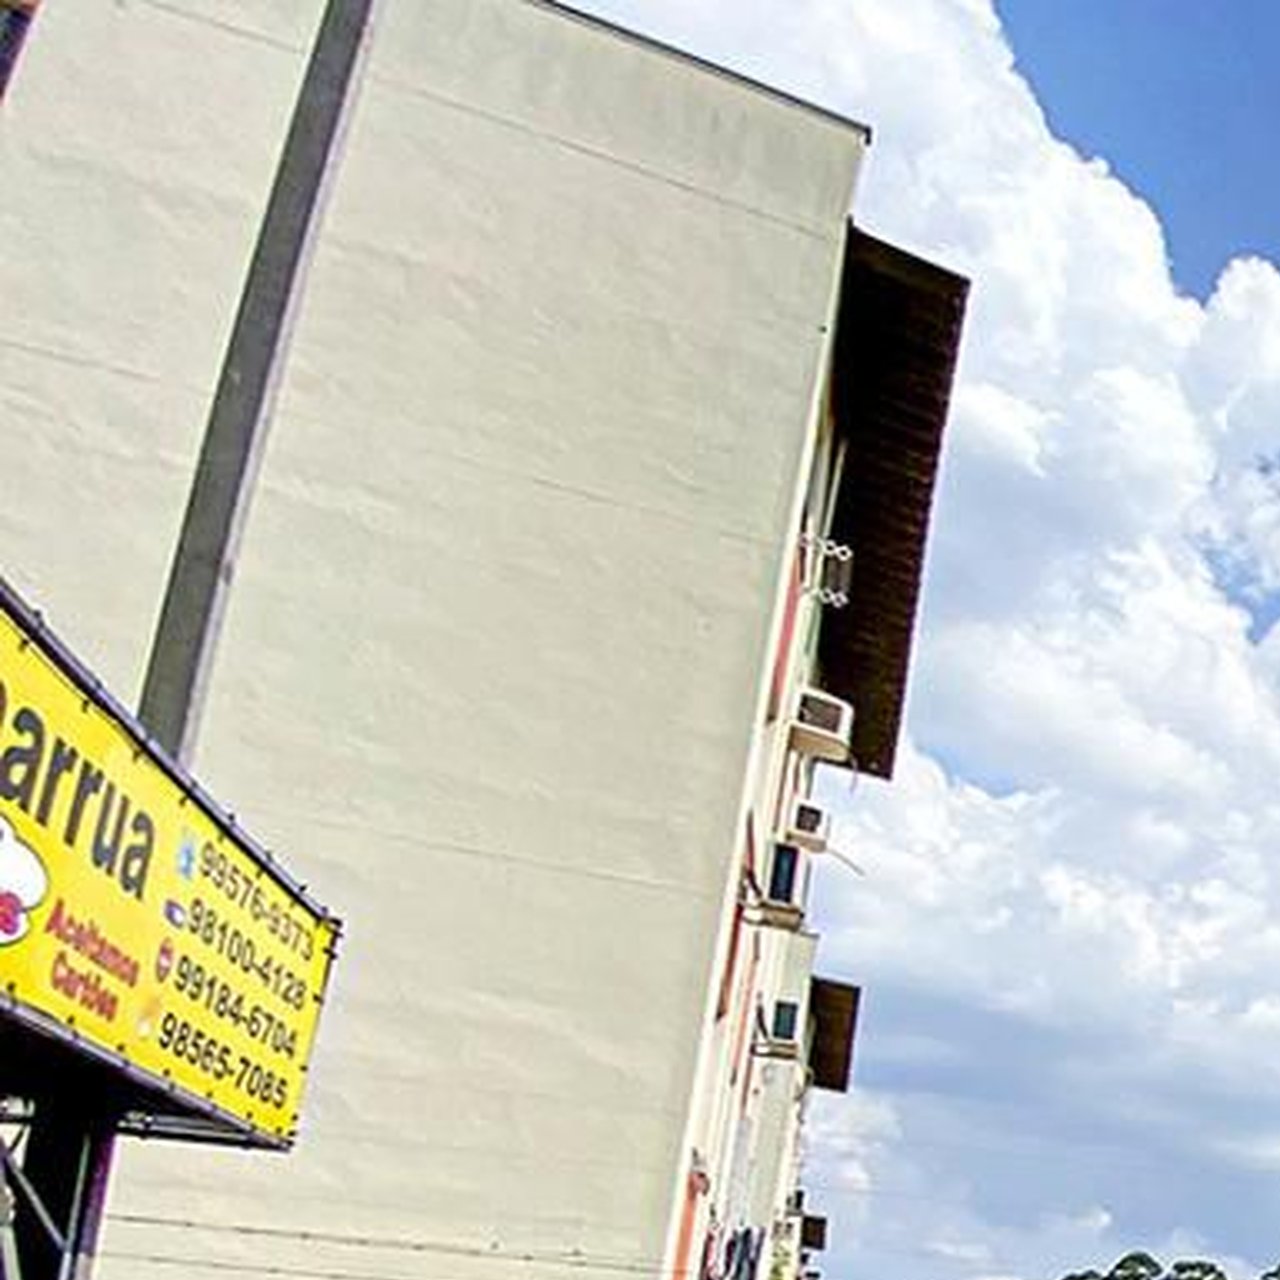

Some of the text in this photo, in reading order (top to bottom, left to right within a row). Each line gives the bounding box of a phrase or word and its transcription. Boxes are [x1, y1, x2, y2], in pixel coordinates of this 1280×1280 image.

[0, 680, 154, 900] arrua
[174, 955, 297, 1059] 99184-6704
[158, 1012, 288, 1109] 98565-7085
